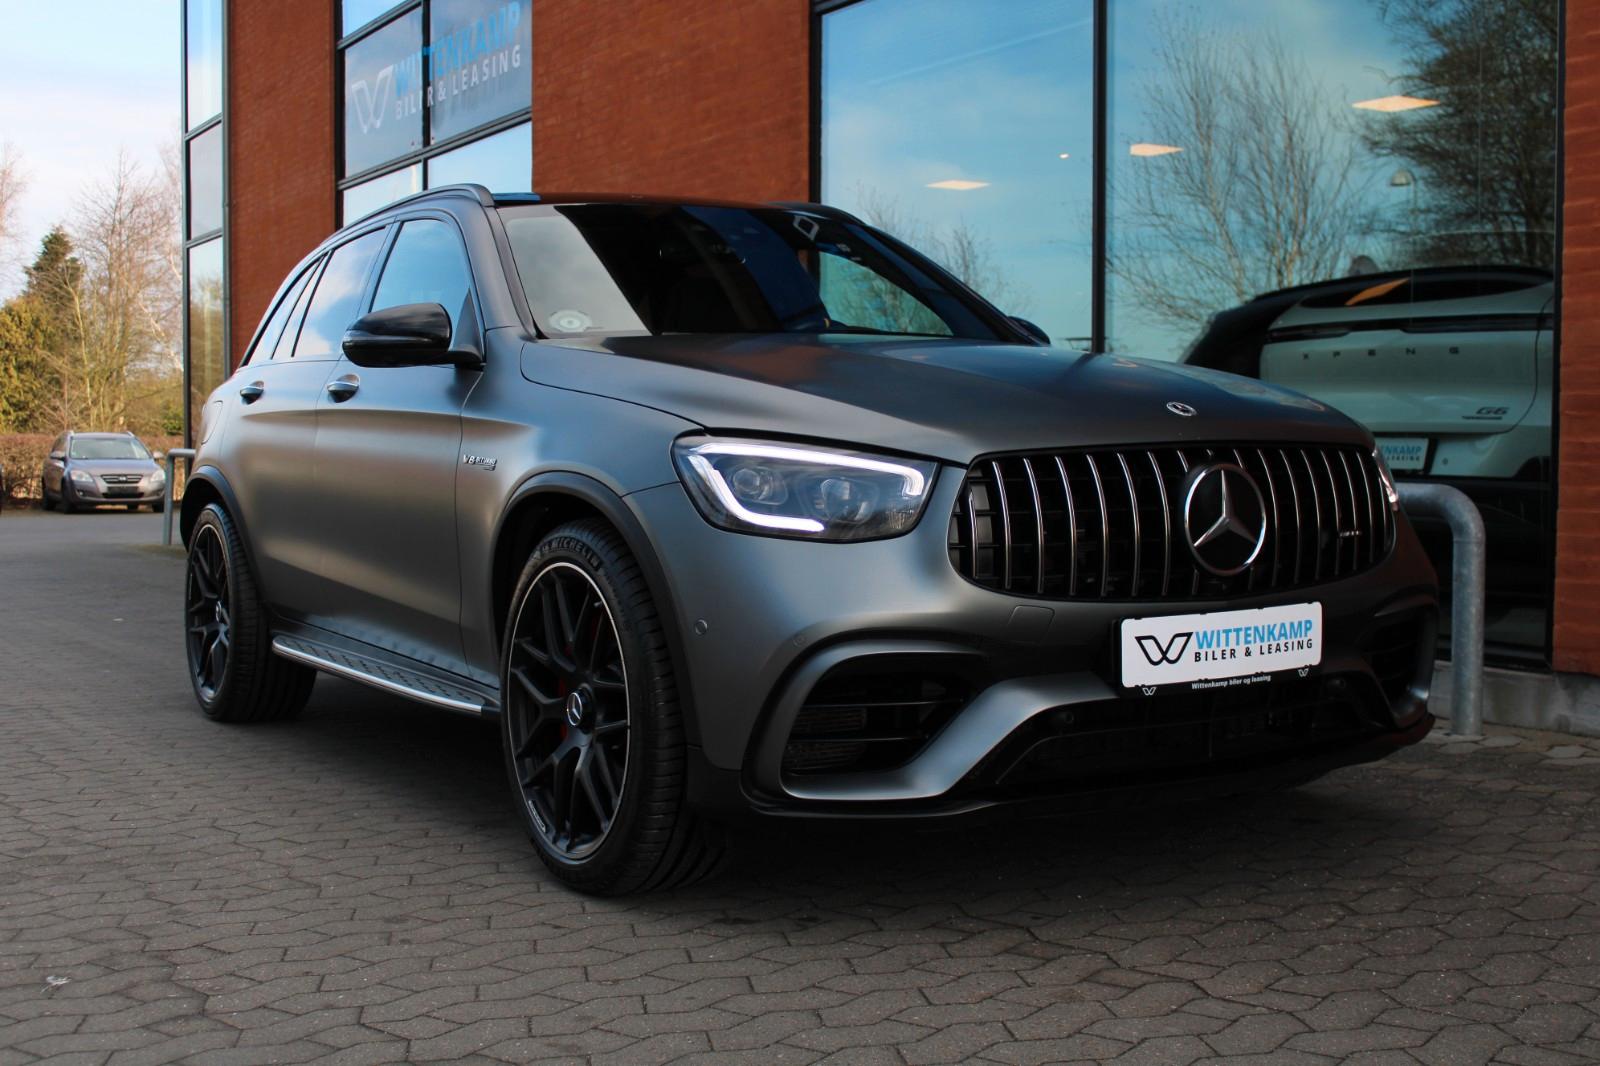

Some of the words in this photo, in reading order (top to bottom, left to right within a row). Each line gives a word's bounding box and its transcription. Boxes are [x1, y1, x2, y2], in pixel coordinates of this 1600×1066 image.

[438, 81, 447, 101] &
[452, 45, 521, 96] LEASING
[1303, 347, 1459, 359] XPENG
[1476, 406, 1509, 415] G6
[551, 537, 600, 568] MICHELIN
[1195, 619, 1313, 650] WITTENKAMP
[1194, 649, 1236, 663] BILER
[1244, 646, 1252, 657] &
[1259, 638, 1313, 655] LEASING
[1191, 681, 1228, 690] Wittenkamp
[1229, 677, 1242, 686] biler
[1243, 677, 1250, 685] og
[1251, 674, 1271, 683] leasing
